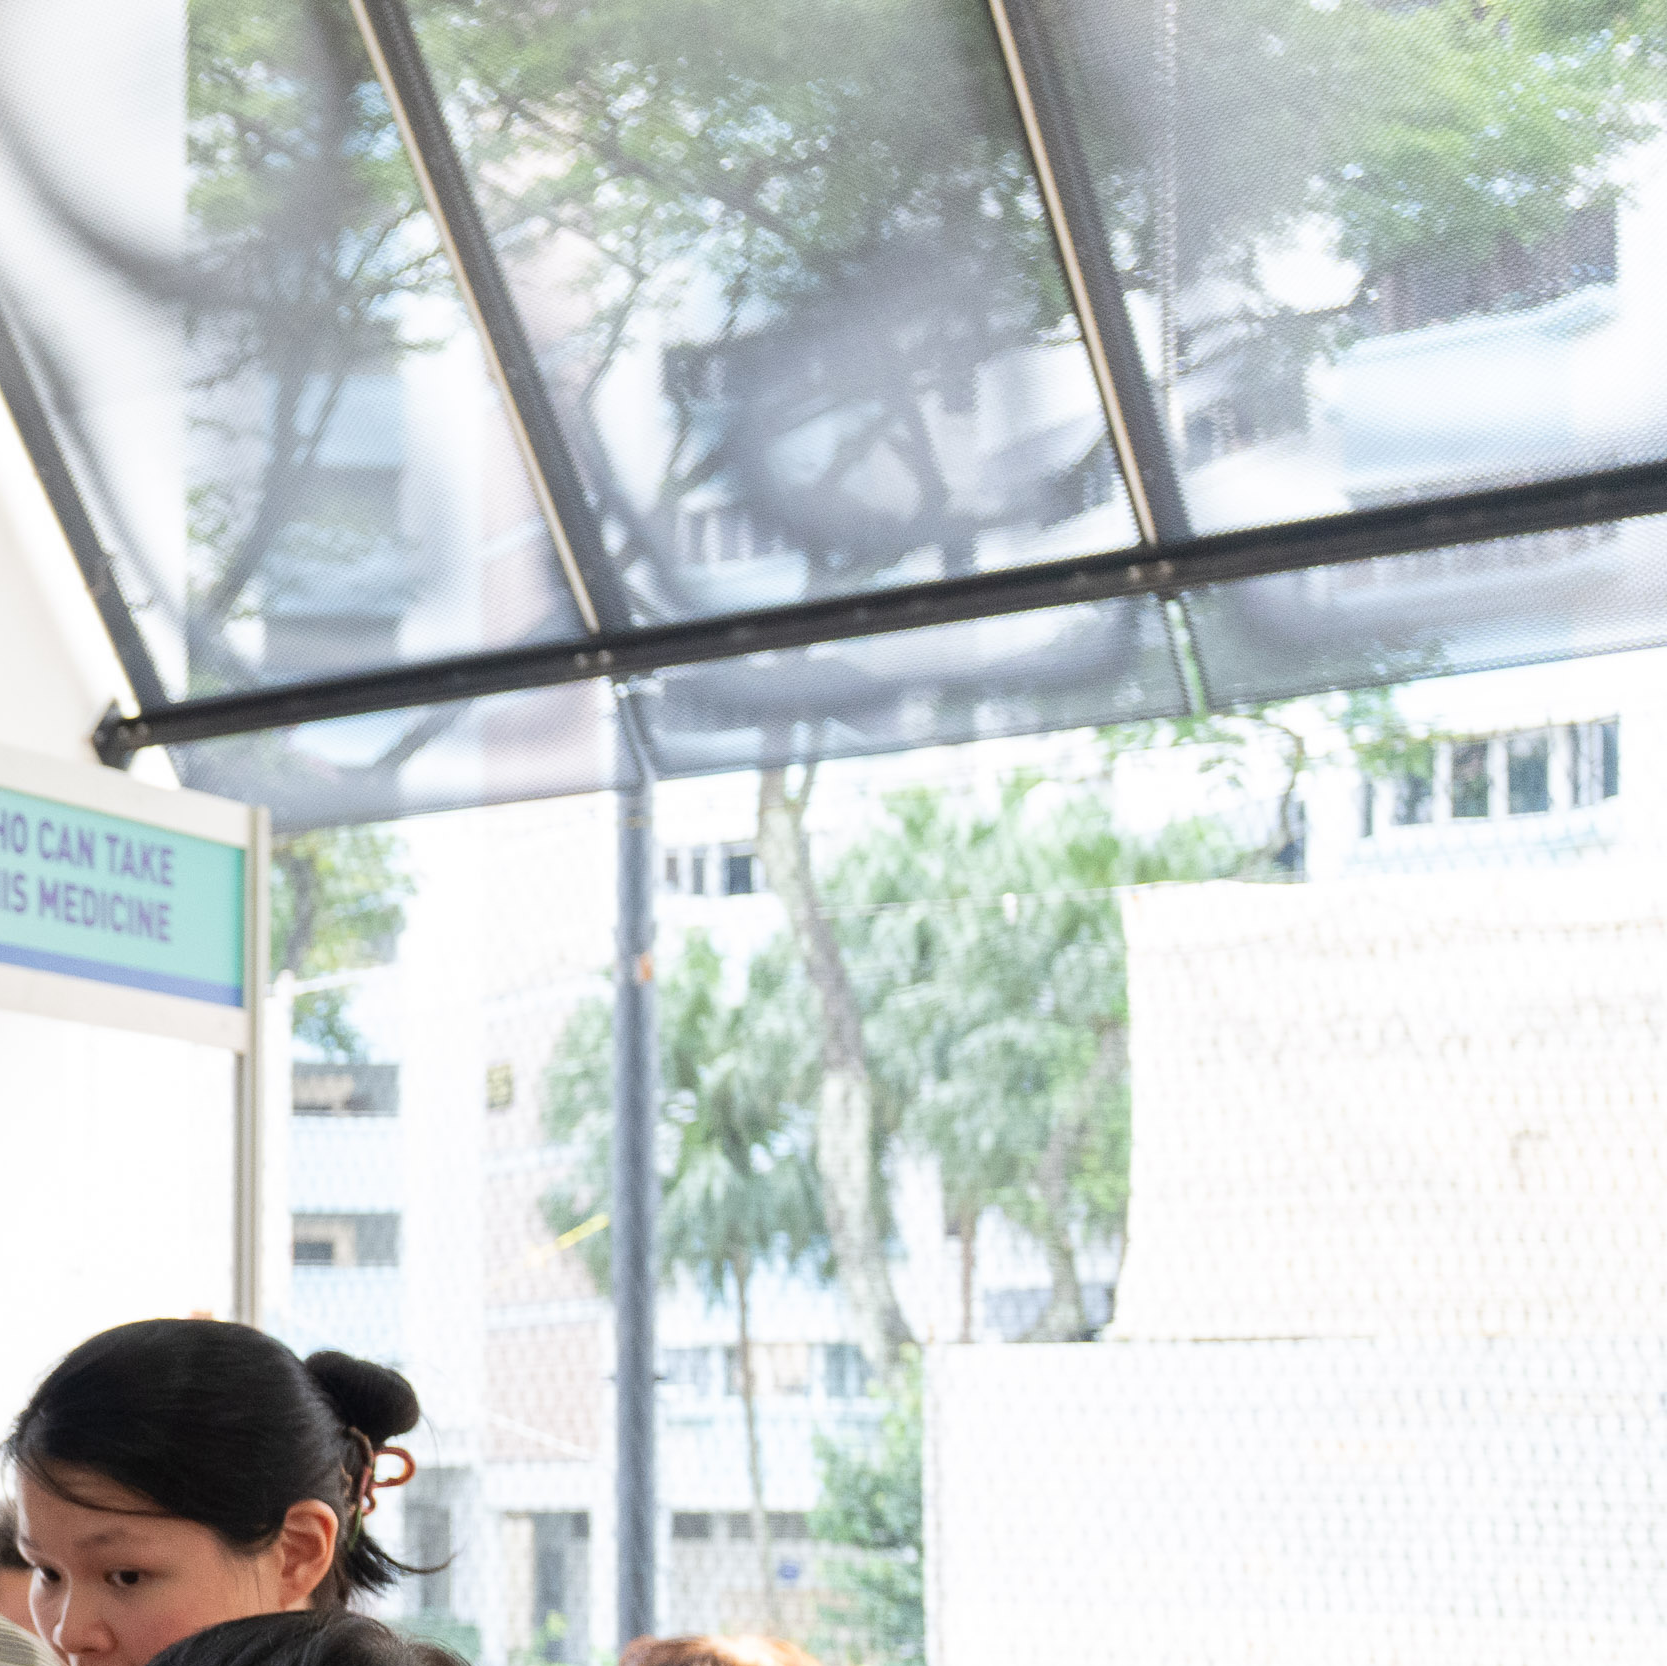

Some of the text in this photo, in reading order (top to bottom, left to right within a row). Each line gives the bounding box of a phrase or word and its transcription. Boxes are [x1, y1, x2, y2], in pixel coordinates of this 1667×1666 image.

[37, 820, 96, 872] CAN
[104, 834, 175, 888] TAKE
[38, 877, 172, 943] MEDICINE
